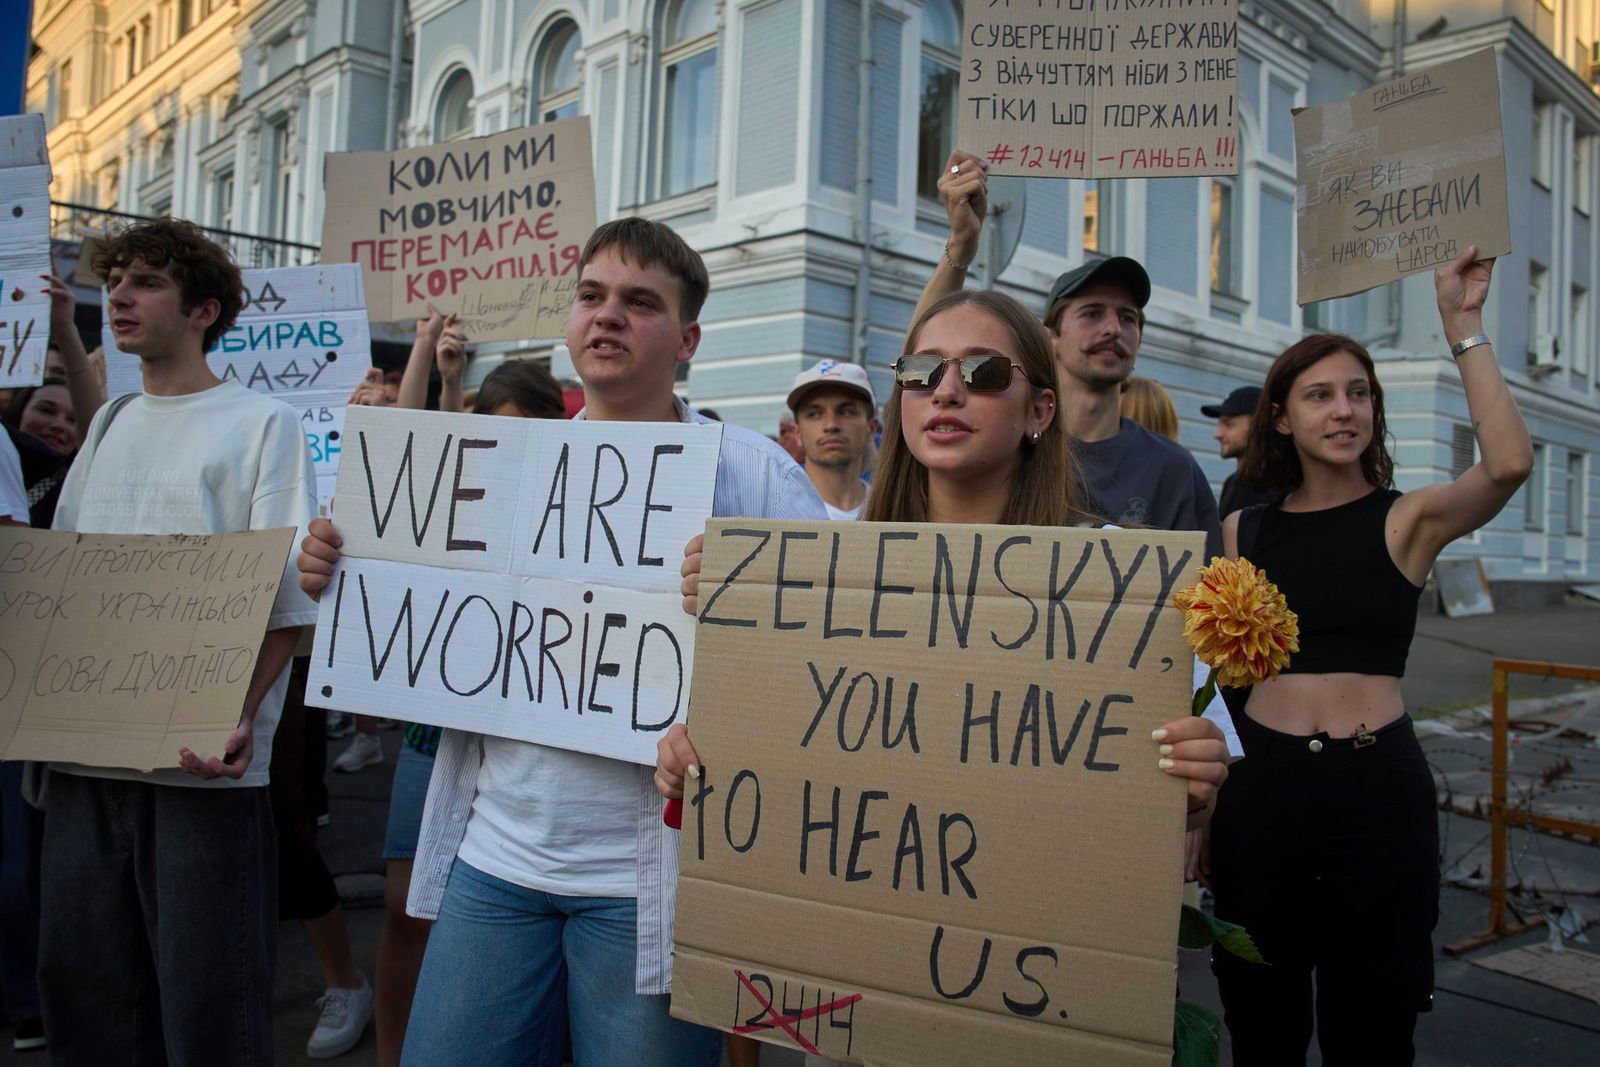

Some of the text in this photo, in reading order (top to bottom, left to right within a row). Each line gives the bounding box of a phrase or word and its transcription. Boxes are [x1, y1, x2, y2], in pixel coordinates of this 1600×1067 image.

[971, 22, 1238, 52] СУВЕРЕННОЇ ДЕРЖАВИ
[968, 59, 982, 82] З
[1176, 61, 1188, 83] З
[1194, 58, 1237, 83] МЕНЕ
[1373, 74, 1431, 105] ГАНЬБА
[1052, 102, 1087, 125] ШО
[389, 133, 555, 195] КОЛИ МИ
[351, 212, 559, 272] ПЕРЕМАГАЄ
[209, 321, 343, 353] БИРАВ
[359, 431, 684, 567] WE ARE
[0, 542, 264, 582] ВИ ПРОПУСТИЛИ
[0, 591, 79, 620] УРОК
[700, 529, 1193, 672] ZELENSKYY,
[34, 654, 112, 697] СОВА
[800, 662, 1135, 772] YOU HAVE
[799, 780, 978, 899] HEAR
